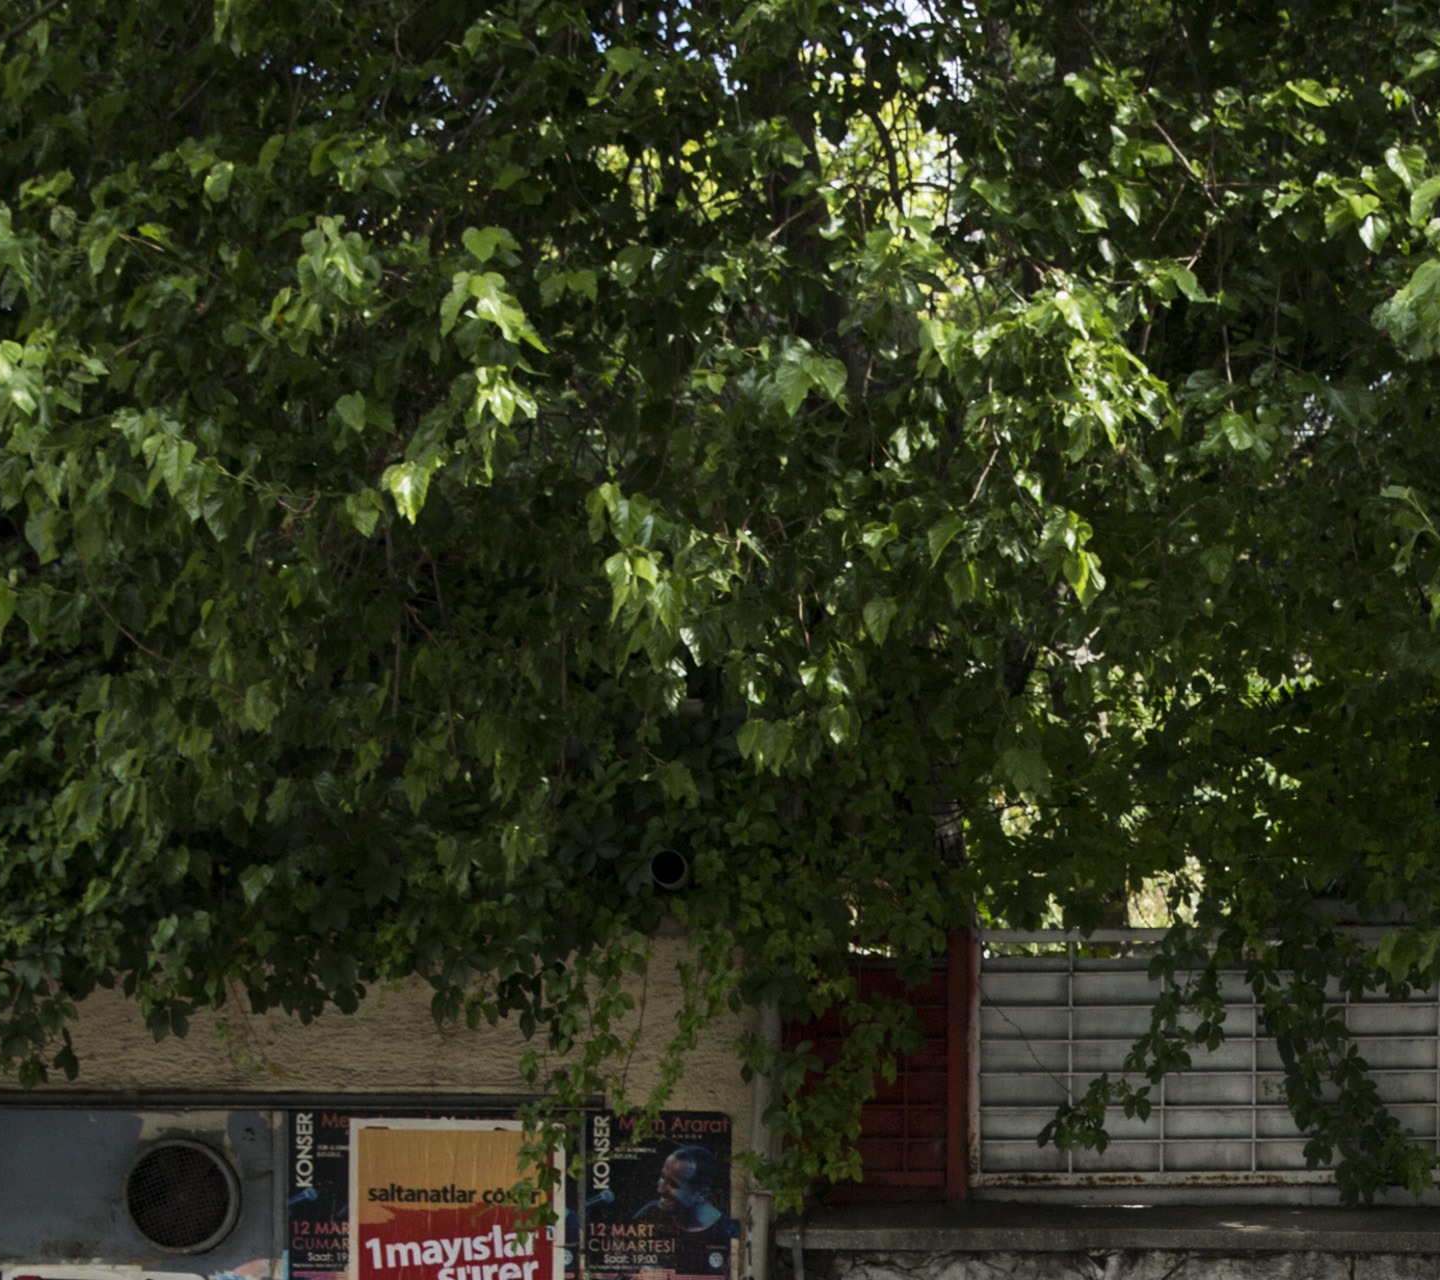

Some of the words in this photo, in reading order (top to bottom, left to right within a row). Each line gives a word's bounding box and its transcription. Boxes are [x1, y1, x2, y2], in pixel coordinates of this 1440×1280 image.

[321, 1112, 349, 1129] Me
[618, 1116, 666, 1132] Mm
[671, 1117, 728, 1134] Ararat
[296, 1112, 314, 1188] KONSER
[593, 1115, 611, 1190] KONSER
[367, 1183, 477, 1204] saltanatlar
[293, 1221, 311, 1235] 12
[314, 1221, 349, 1235] MAR
[588, 1222, 606, 1237] 12
[611, 1223, 654, 1237] MART
[588, 1238, 676, 1253] CUMARTESİ
[307, 1251, 334, 1262] Saat:
[603, 1254, 629, 1265] Saat:
[632, 1254, 658, 1265] 19:00
